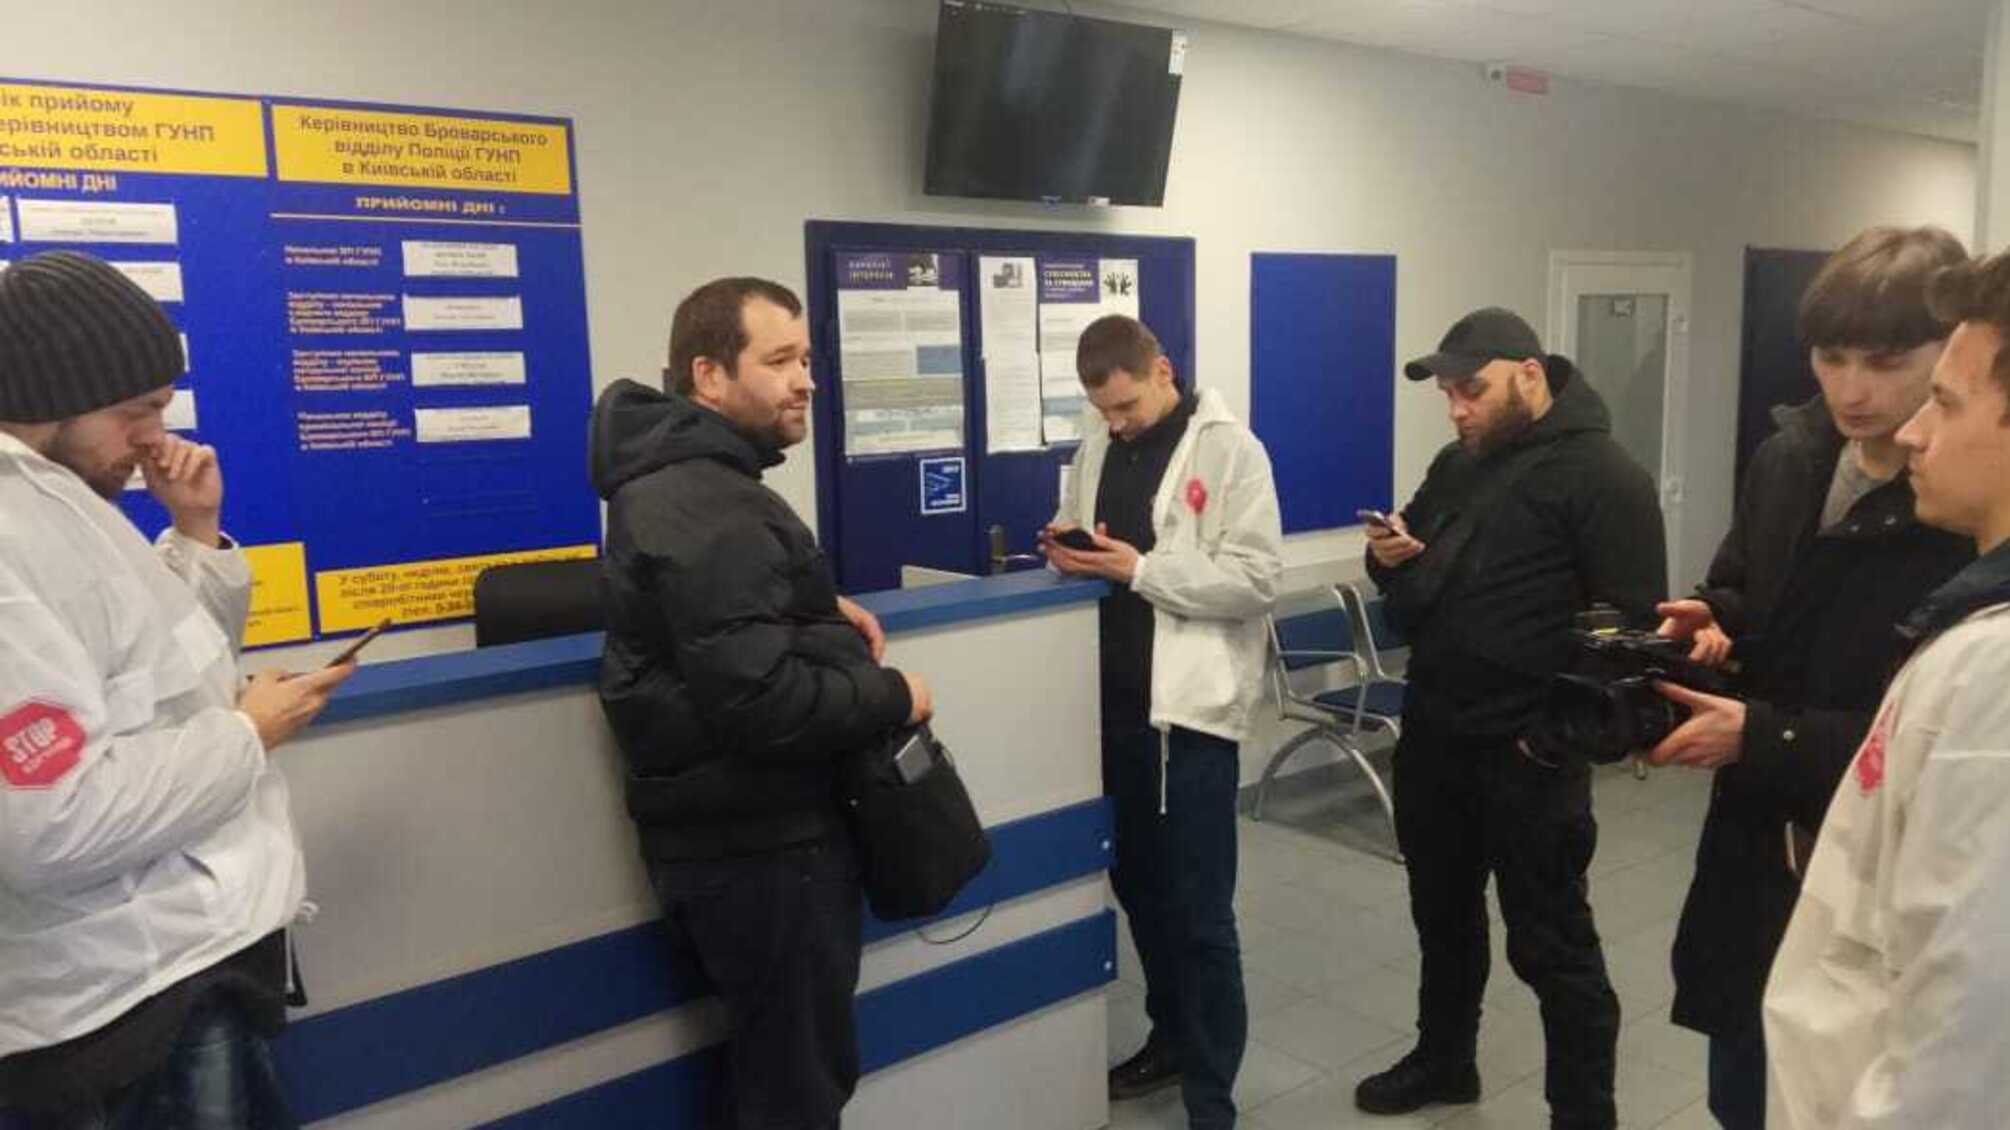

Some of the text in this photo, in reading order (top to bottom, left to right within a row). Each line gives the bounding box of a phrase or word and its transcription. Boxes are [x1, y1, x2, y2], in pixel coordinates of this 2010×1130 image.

[30, 95, 134, 117] прийому
[155, 123, 214, 142] ГУНП
[299, 115, 549, 148] Керівництво Броварського
[69, 144, 158, 163] області
[335, 141, 521, 163] відділу Поліції ГУНП
[342, 160, 518, 183] в Київській області
[82, 174, 118, 193] ДНІ
[354, 195, 457, 212] ПРИЙОМНІ
[4, 718, 57, 763] STOP
